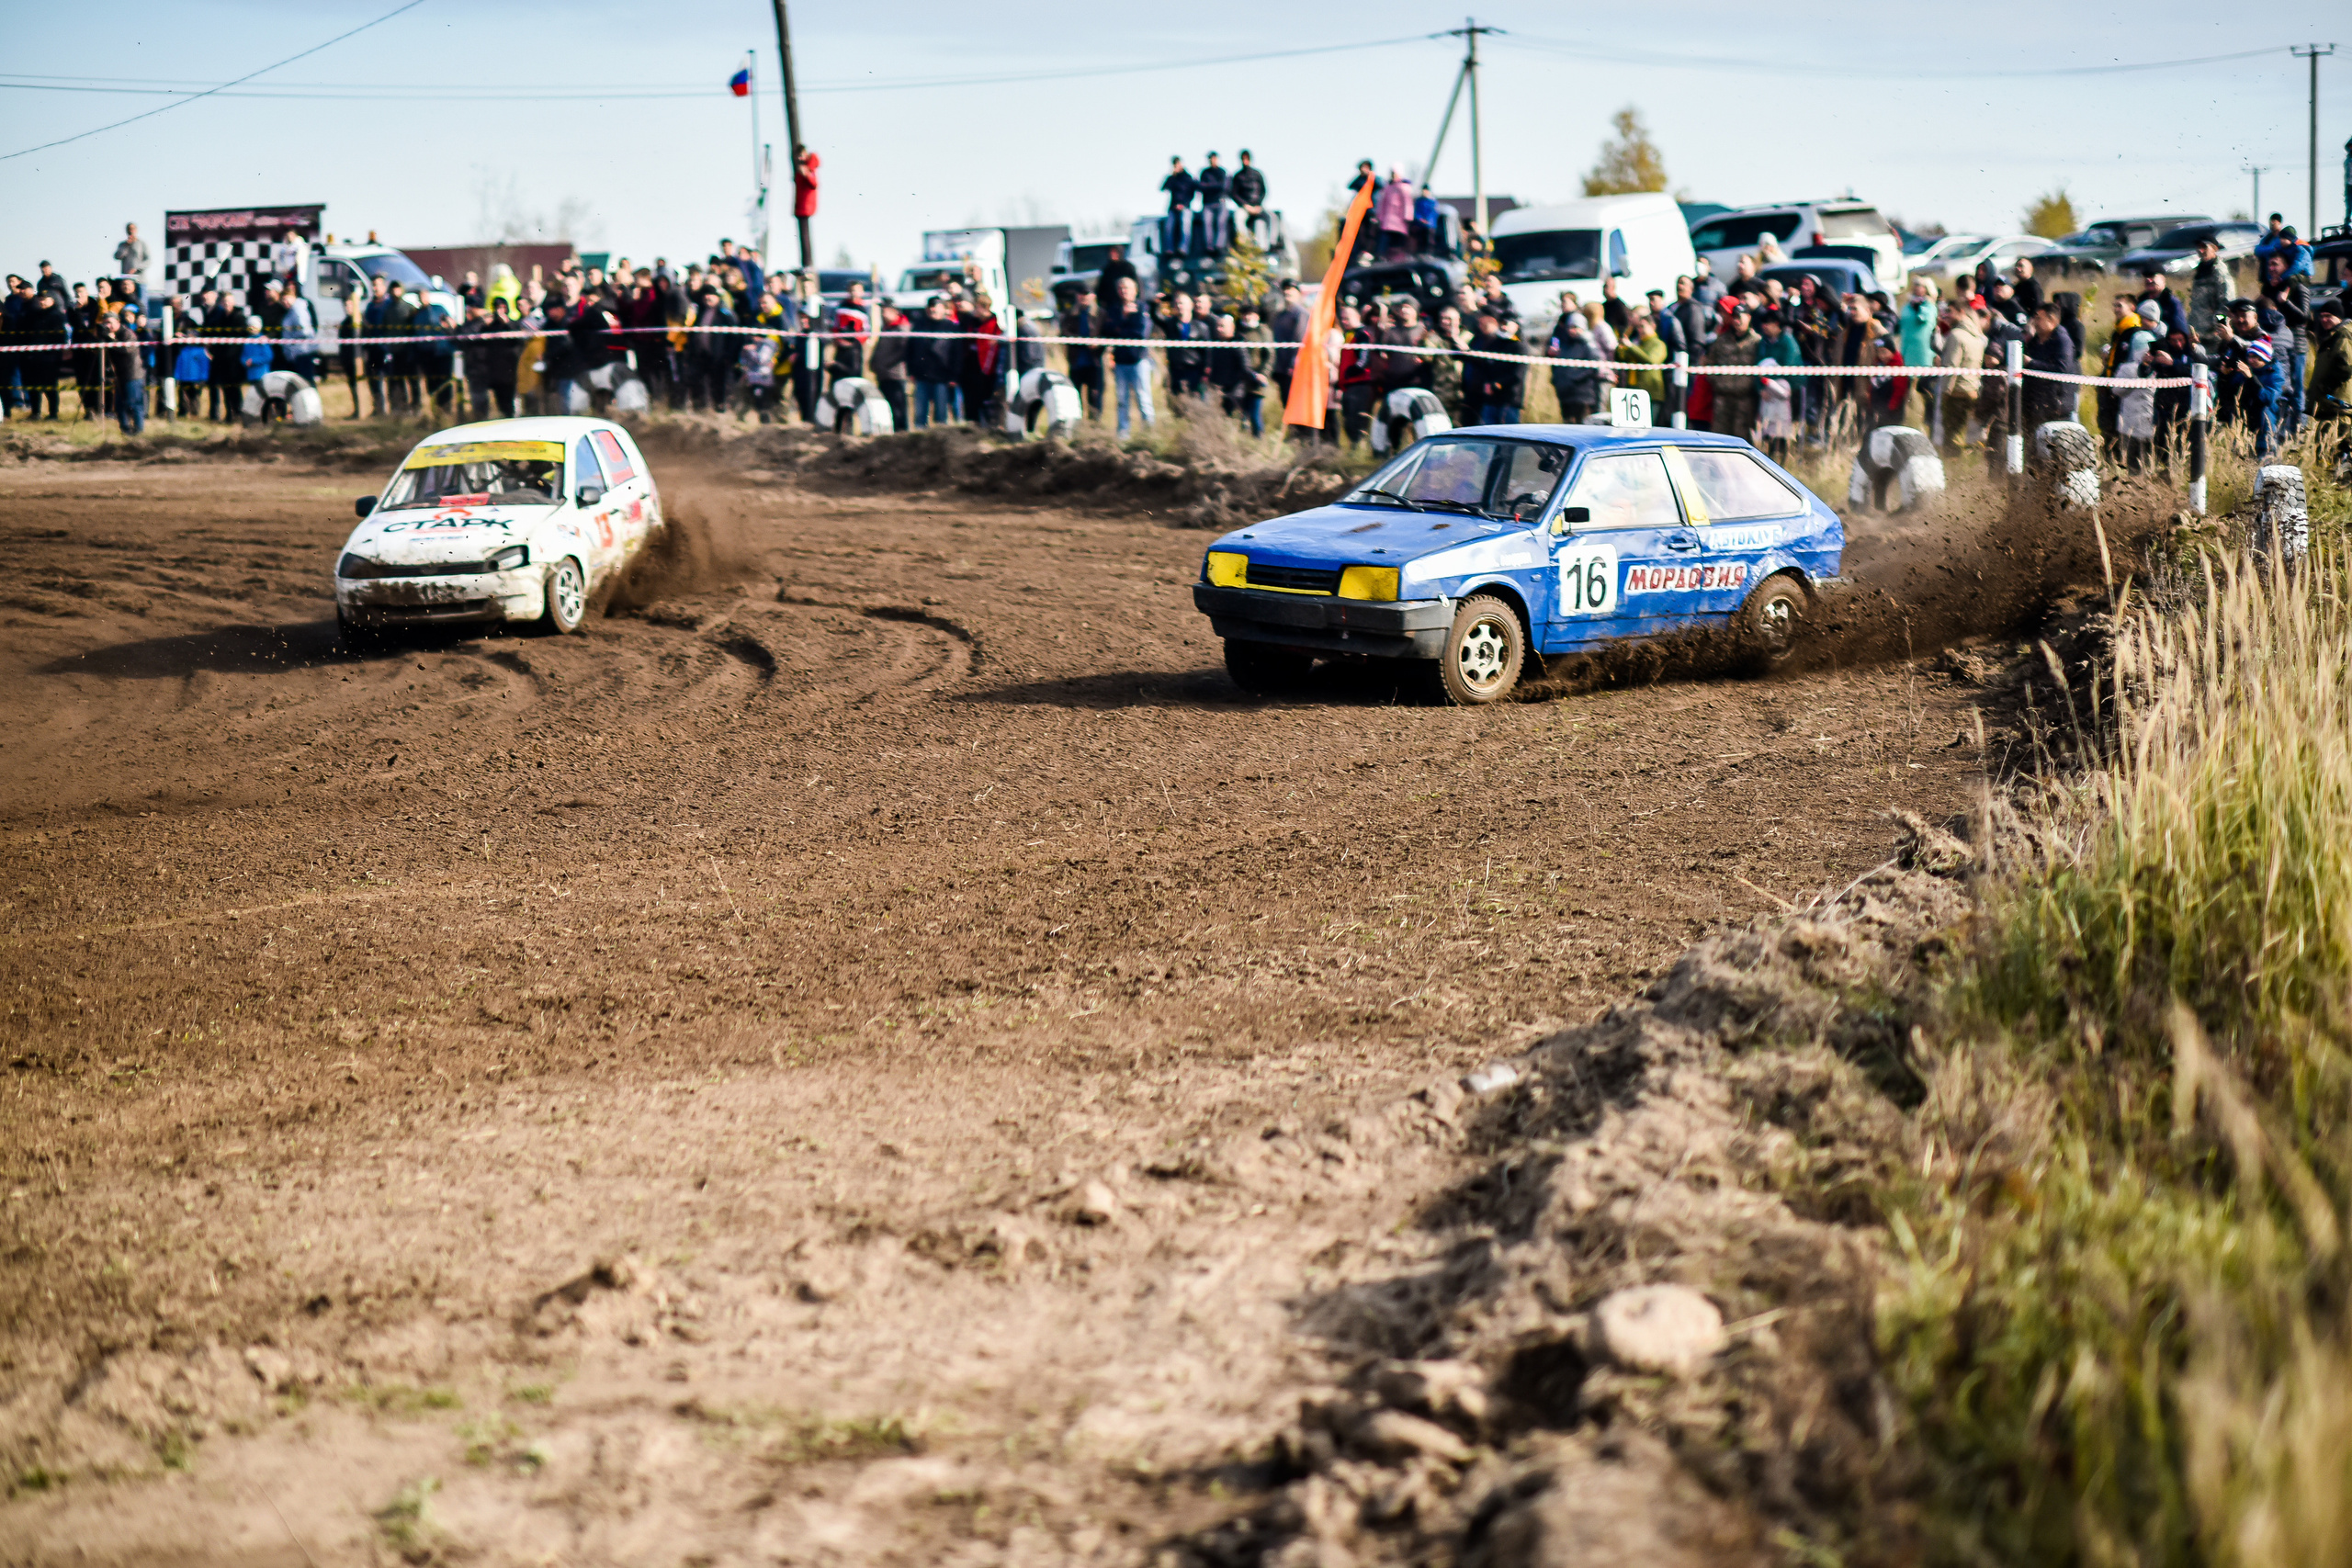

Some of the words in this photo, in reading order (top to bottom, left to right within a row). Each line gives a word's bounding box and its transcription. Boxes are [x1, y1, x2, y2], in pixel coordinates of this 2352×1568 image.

[1621, 393, 1641, 422] 16
[383, 517, 514, 533] СТАРК
[1566, 556, 1607, 610] 16
[1628, 566, 1745, 591] МОРДОВИЯ
